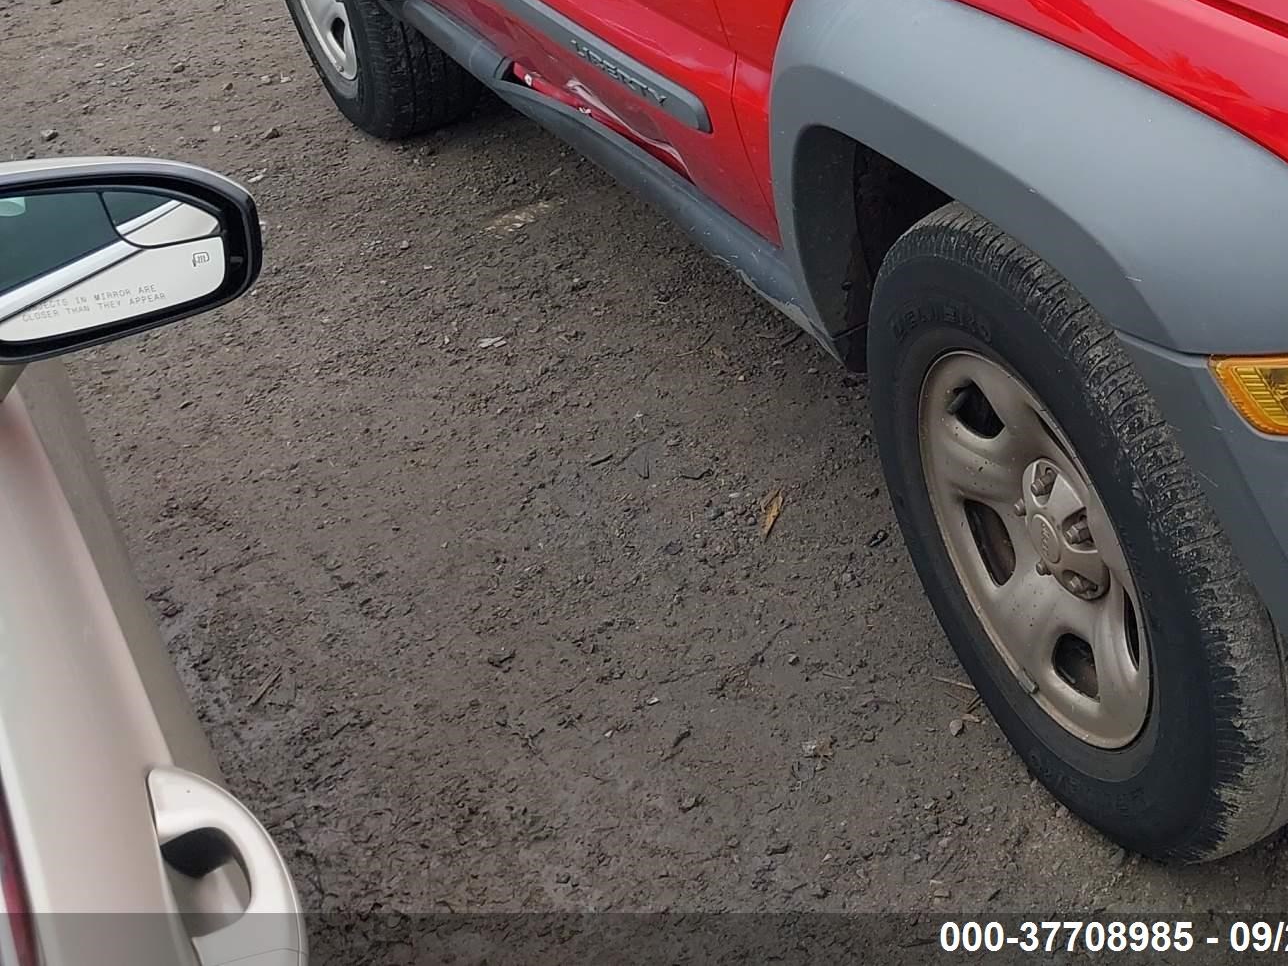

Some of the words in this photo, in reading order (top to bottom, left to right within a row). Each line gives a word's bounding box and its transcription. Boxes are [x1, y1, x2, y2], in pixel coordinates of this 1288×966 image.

[21, 309, 59, 323] CLOSER
[66, 305, 91, 315] THAN
[98, 300, 121, 310] THEY
[128, 292, 166, 307] APPEAR
[75, 296, 88, 305] IN
[93, 288, 131, 301] MIRROR
[138, 284, 157, 294] ARE
